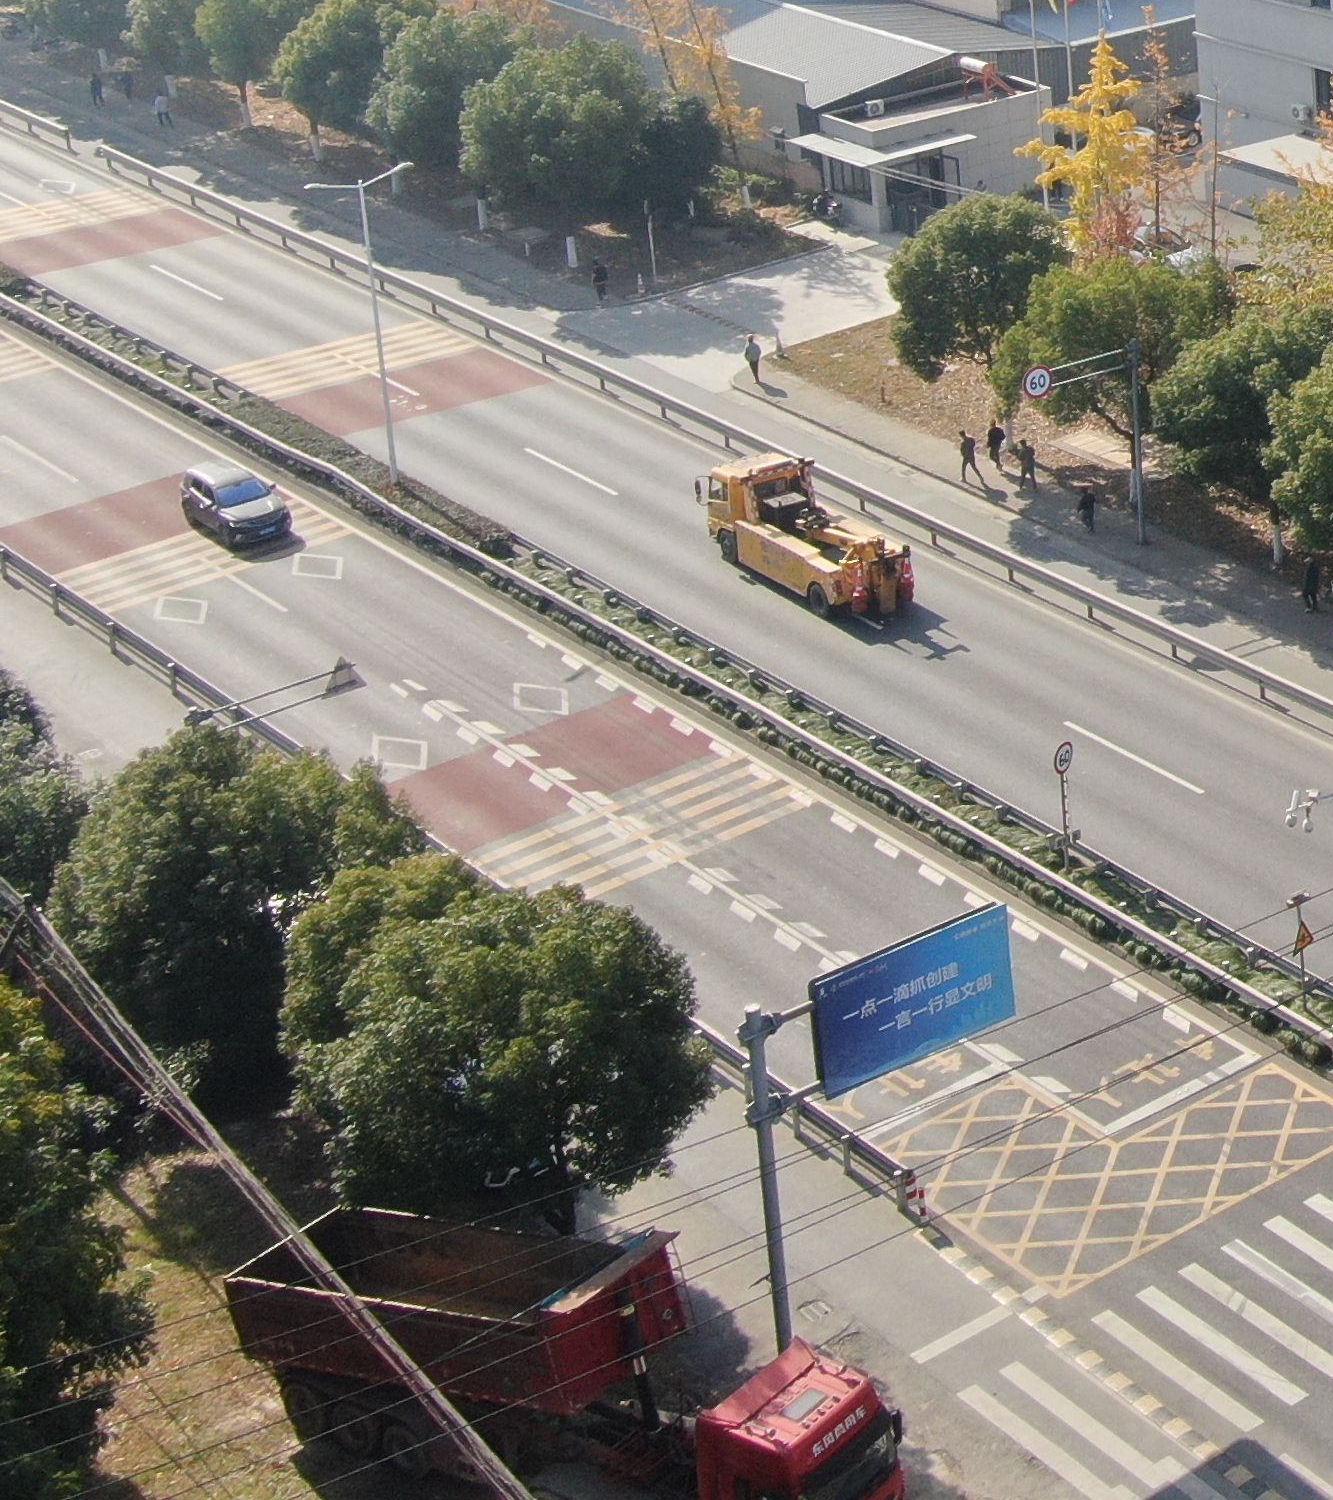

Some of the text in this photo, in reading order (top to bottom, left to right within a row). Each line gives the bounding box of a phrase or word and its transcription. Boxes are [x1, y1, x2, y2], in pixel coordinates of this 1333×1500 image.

[1030, 374, 1046, 390] 60
[1059, 749, 1070, 767] 60
[842, 961, 960, 1020] 一点一滴抓创建
